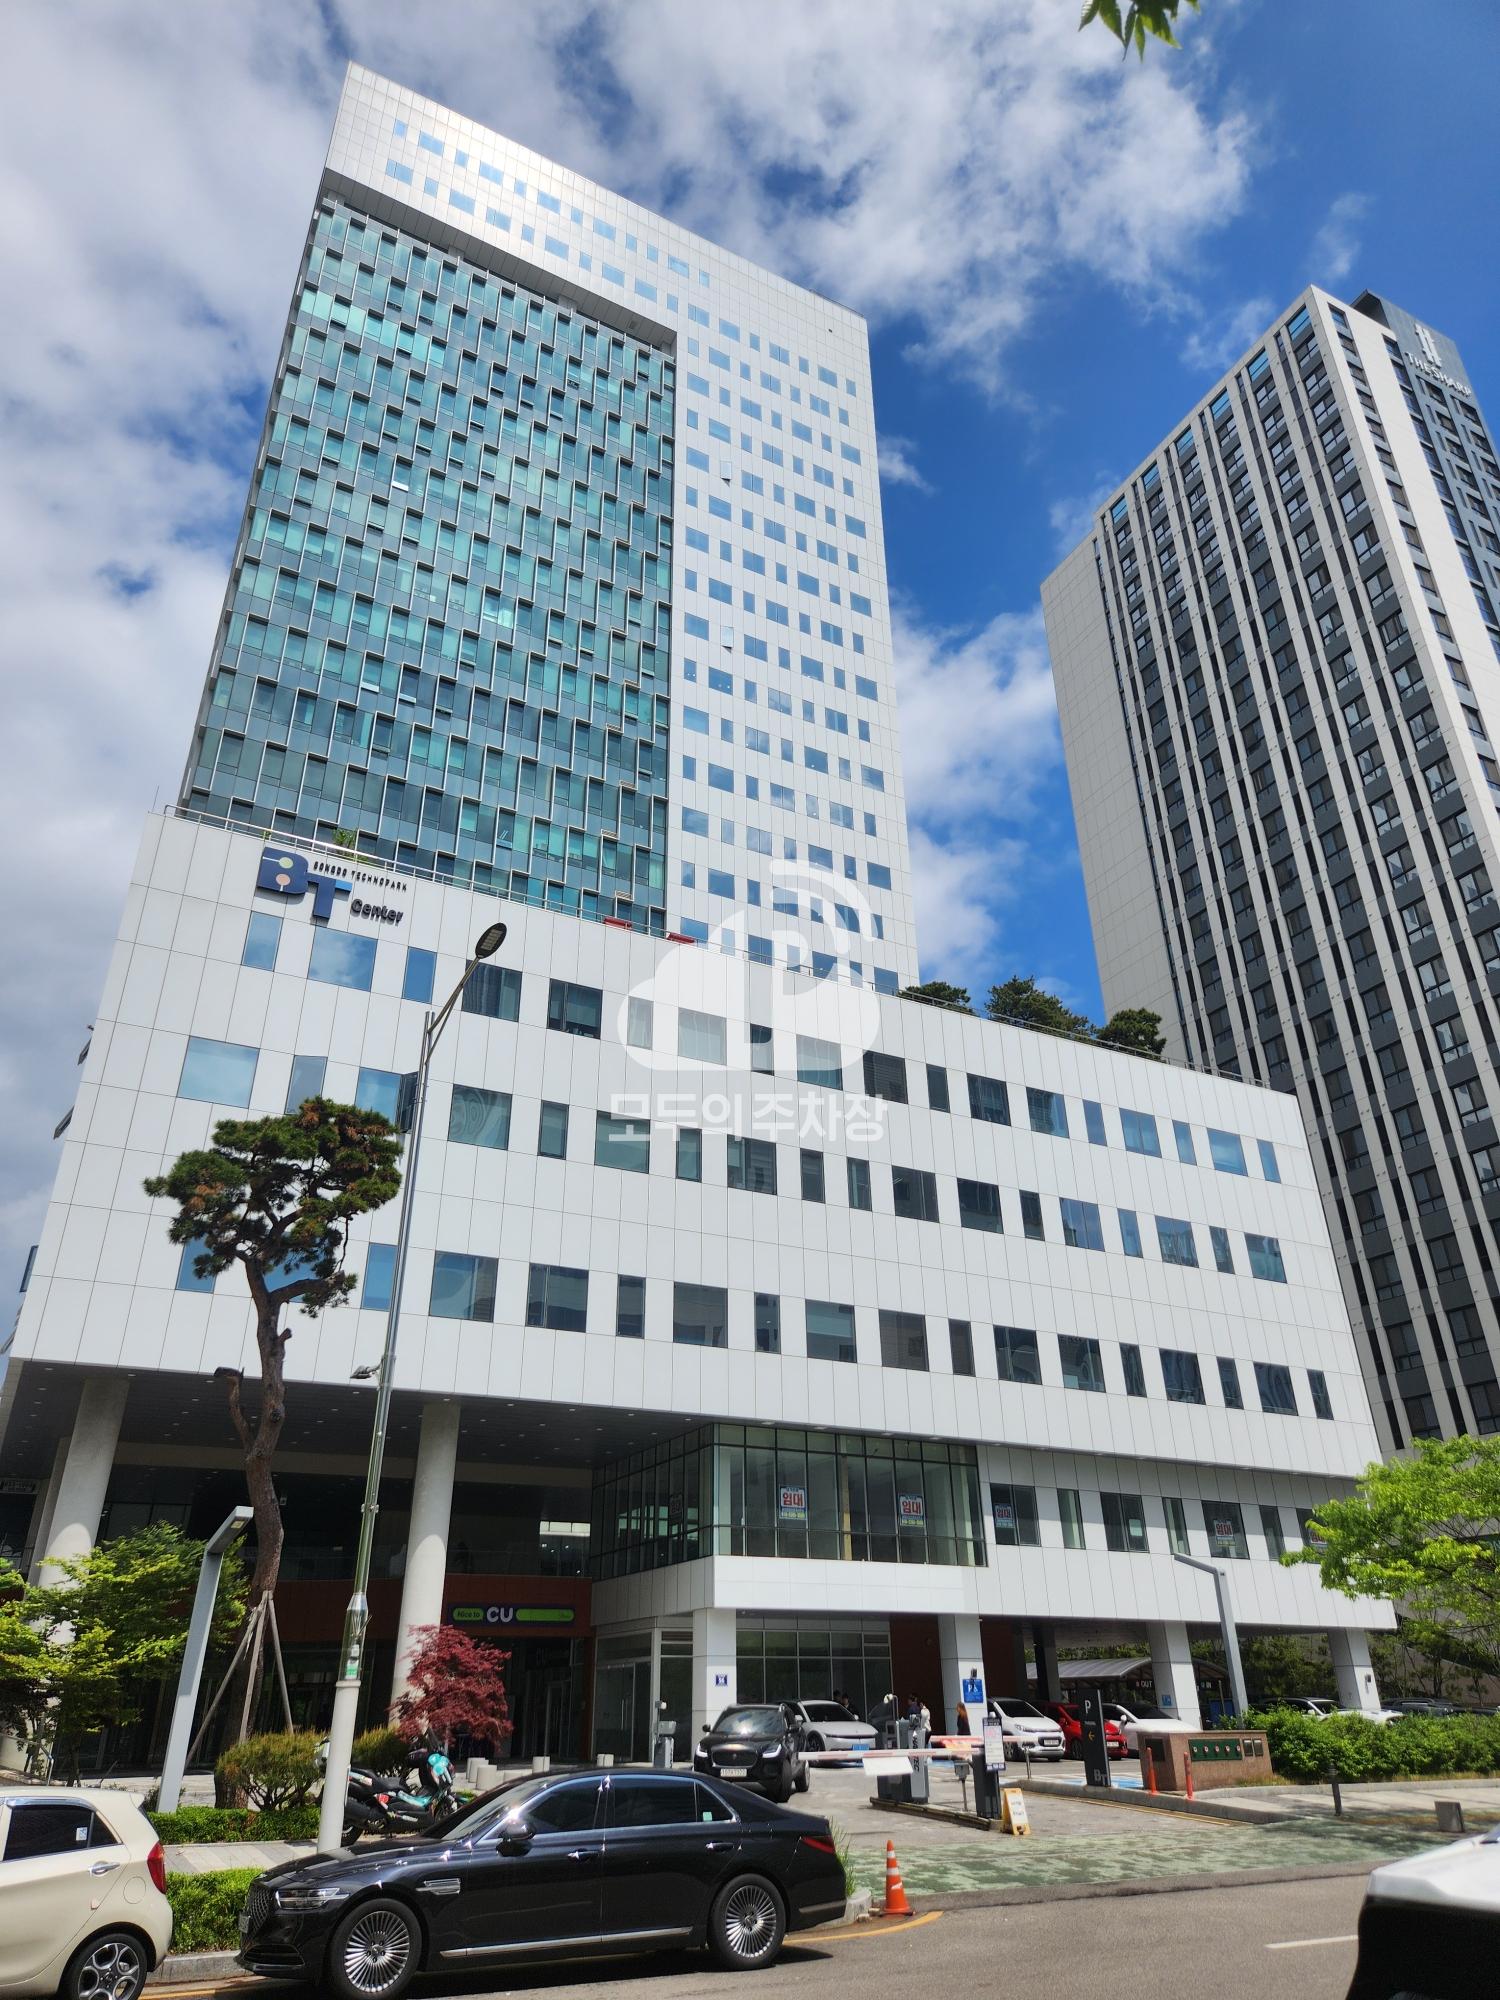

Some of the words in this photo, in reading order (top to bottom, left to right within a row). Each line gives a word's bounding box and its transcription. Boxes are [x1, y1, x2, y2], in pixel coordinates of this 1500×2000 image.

[256, 846, 353, 919] BT
[351, 870, 408, 892] TECHNOPARK
[351, 898, 404, 923] Center
[783, 1492, 803, 1506] 임대
[902, 1500, 921, 1514] 임대
[486, 1606, 514, 1623] CU
[1084, 1699, 1091, 1714] P
